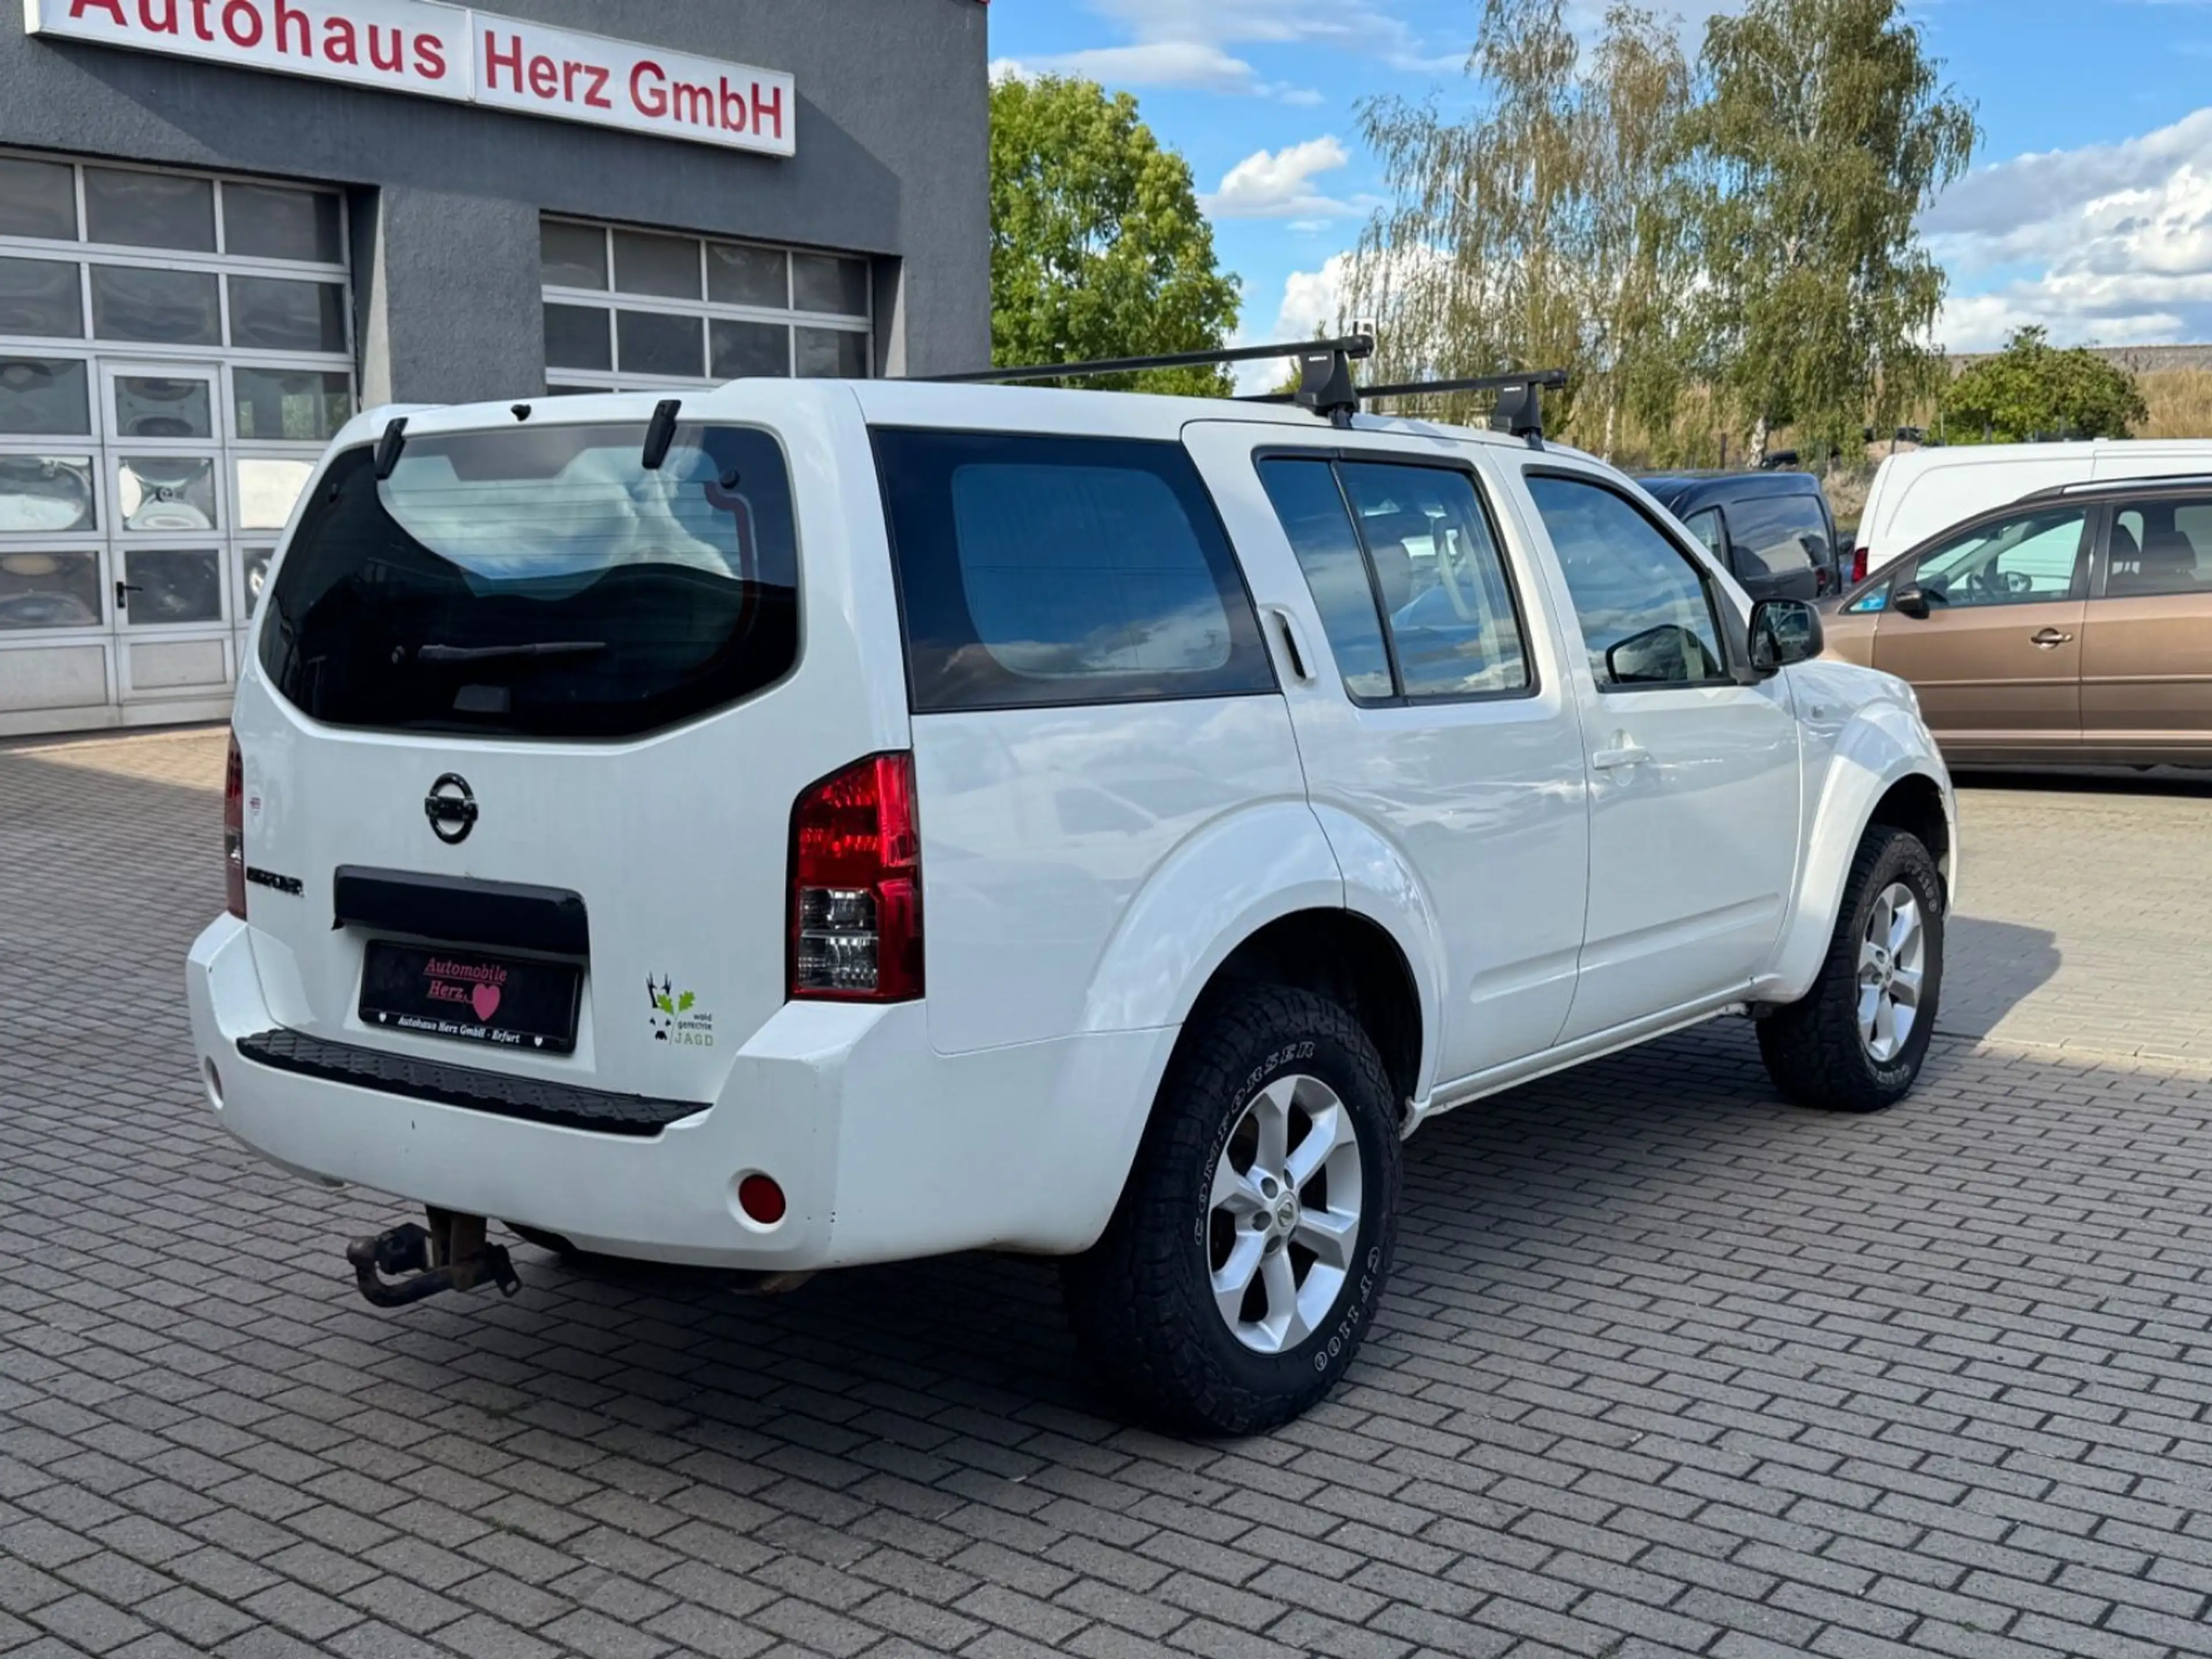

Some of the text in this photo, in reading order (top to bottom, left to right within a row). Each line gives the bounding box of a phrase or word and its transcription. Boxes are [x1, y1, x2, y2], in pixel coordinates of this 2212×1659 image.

[484, 31, 612, 109] Herz
[630, 60, 783, 138] GmbH
[425, 957, 507, 983] Automobile
[397, 1016, 437, 1031] Autohaus
[438, 1021, 459, 1035] Herz
[460, 1025, 486, 1039] GmbH
[491, 1029, 521, 1044] Erfurt
[675, 1032, 713, 1047] JAGD
